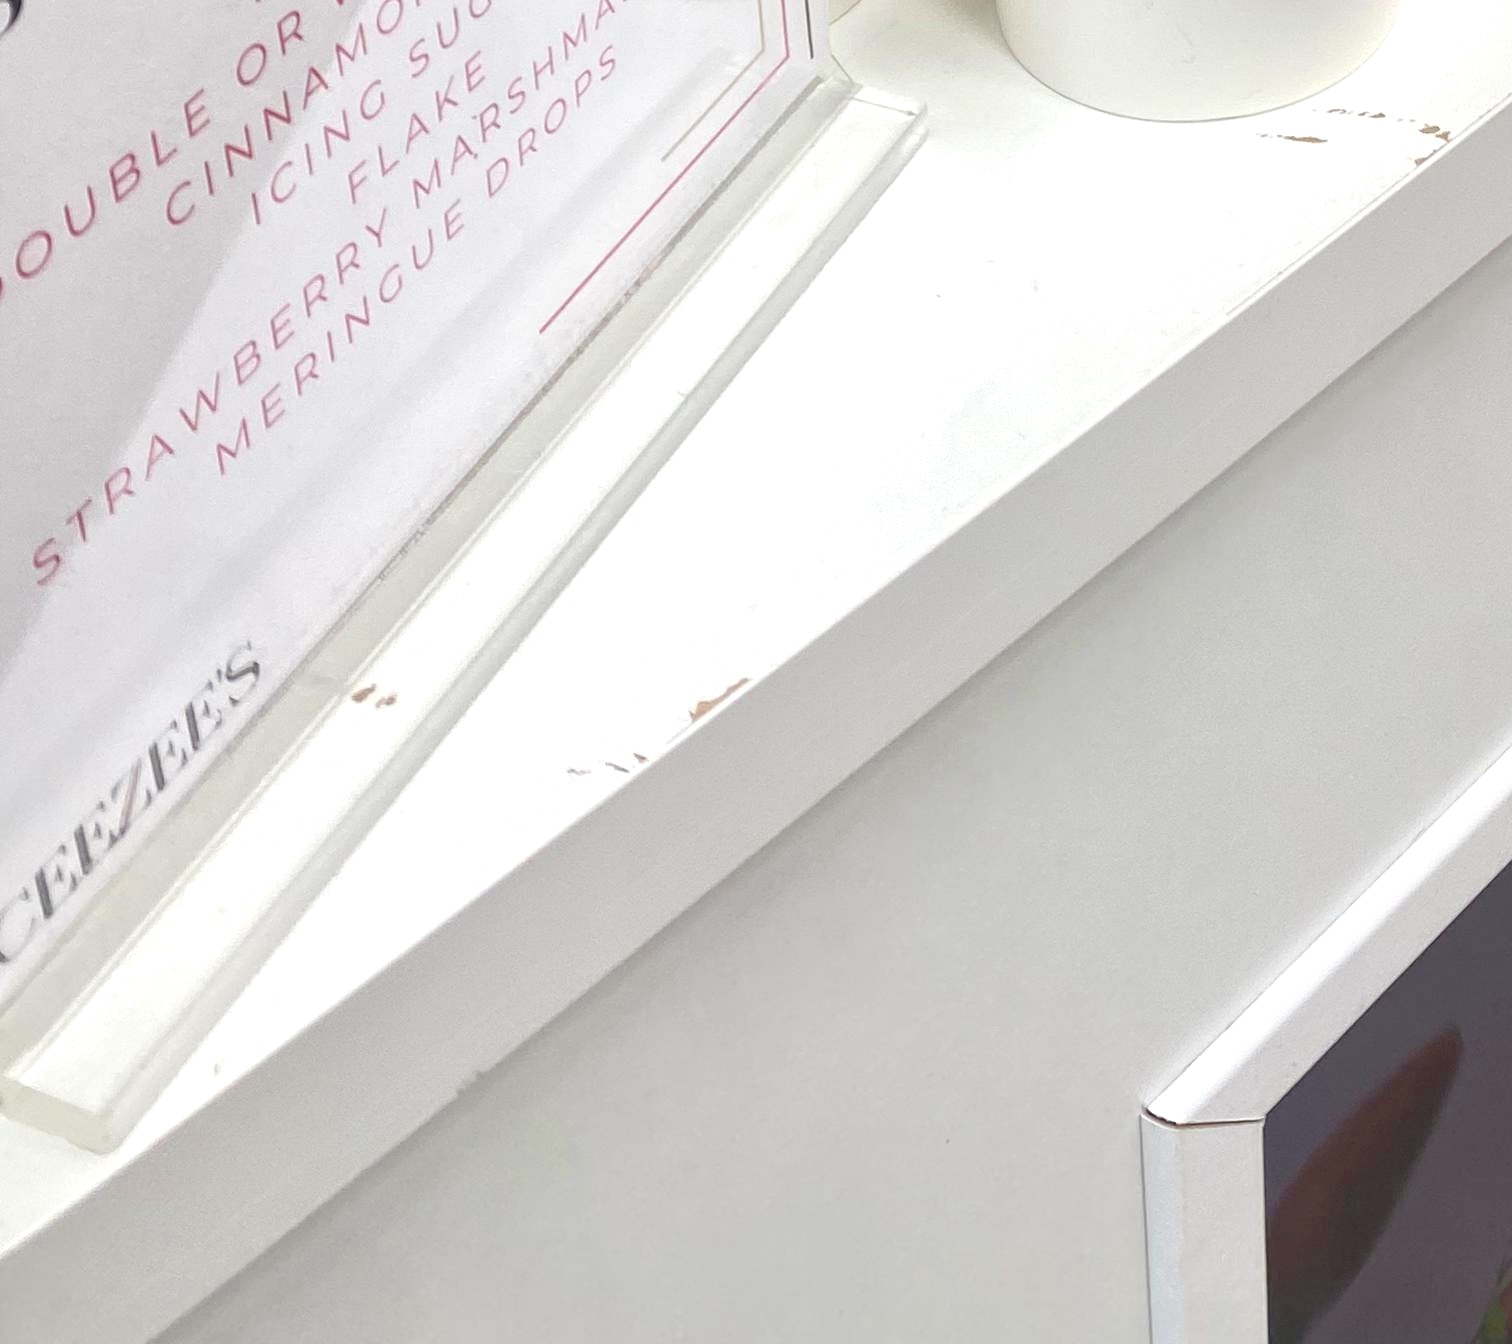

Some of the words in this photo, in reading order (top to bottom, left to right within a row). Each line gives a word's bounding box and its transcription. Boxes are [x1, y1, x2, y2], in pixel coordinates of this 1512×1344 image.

[0, 89, 211, 297] OUBLE
[237, 11, 305, 86] OR
[215, 211, 464, 476] MERINGUE
[487, 48, 619, 193] DROPS
[252, 88, 387, 223] ICING
[349, 51, 485, 204] FLAKE
[31, 209, 389, 586] STRAWBERRY
